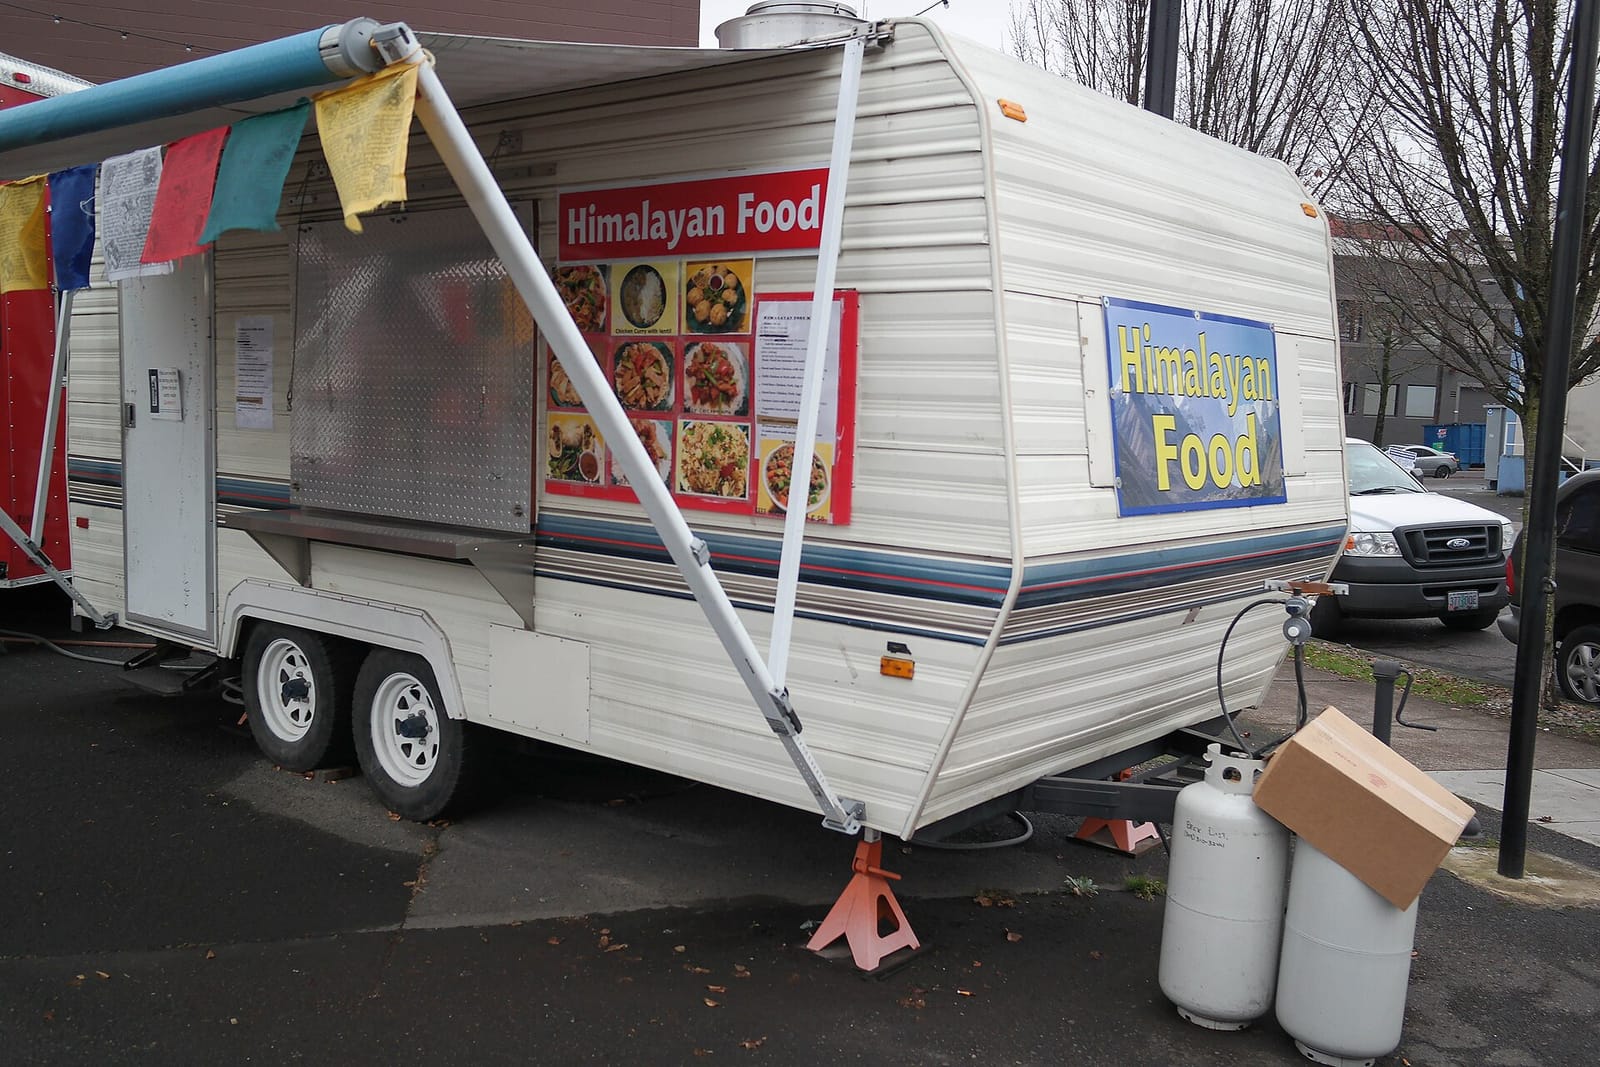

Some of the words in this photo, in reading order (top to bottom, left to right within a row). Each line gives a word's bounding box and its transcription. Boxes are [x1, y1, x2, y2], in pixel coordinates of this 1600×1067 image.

[567, 200, 726, 250] Himalayan
[736, 183, 822, 235] Food
[1117, 323, 1273, 417] Himalayan
[1152, 412, 1262, 492] Food
